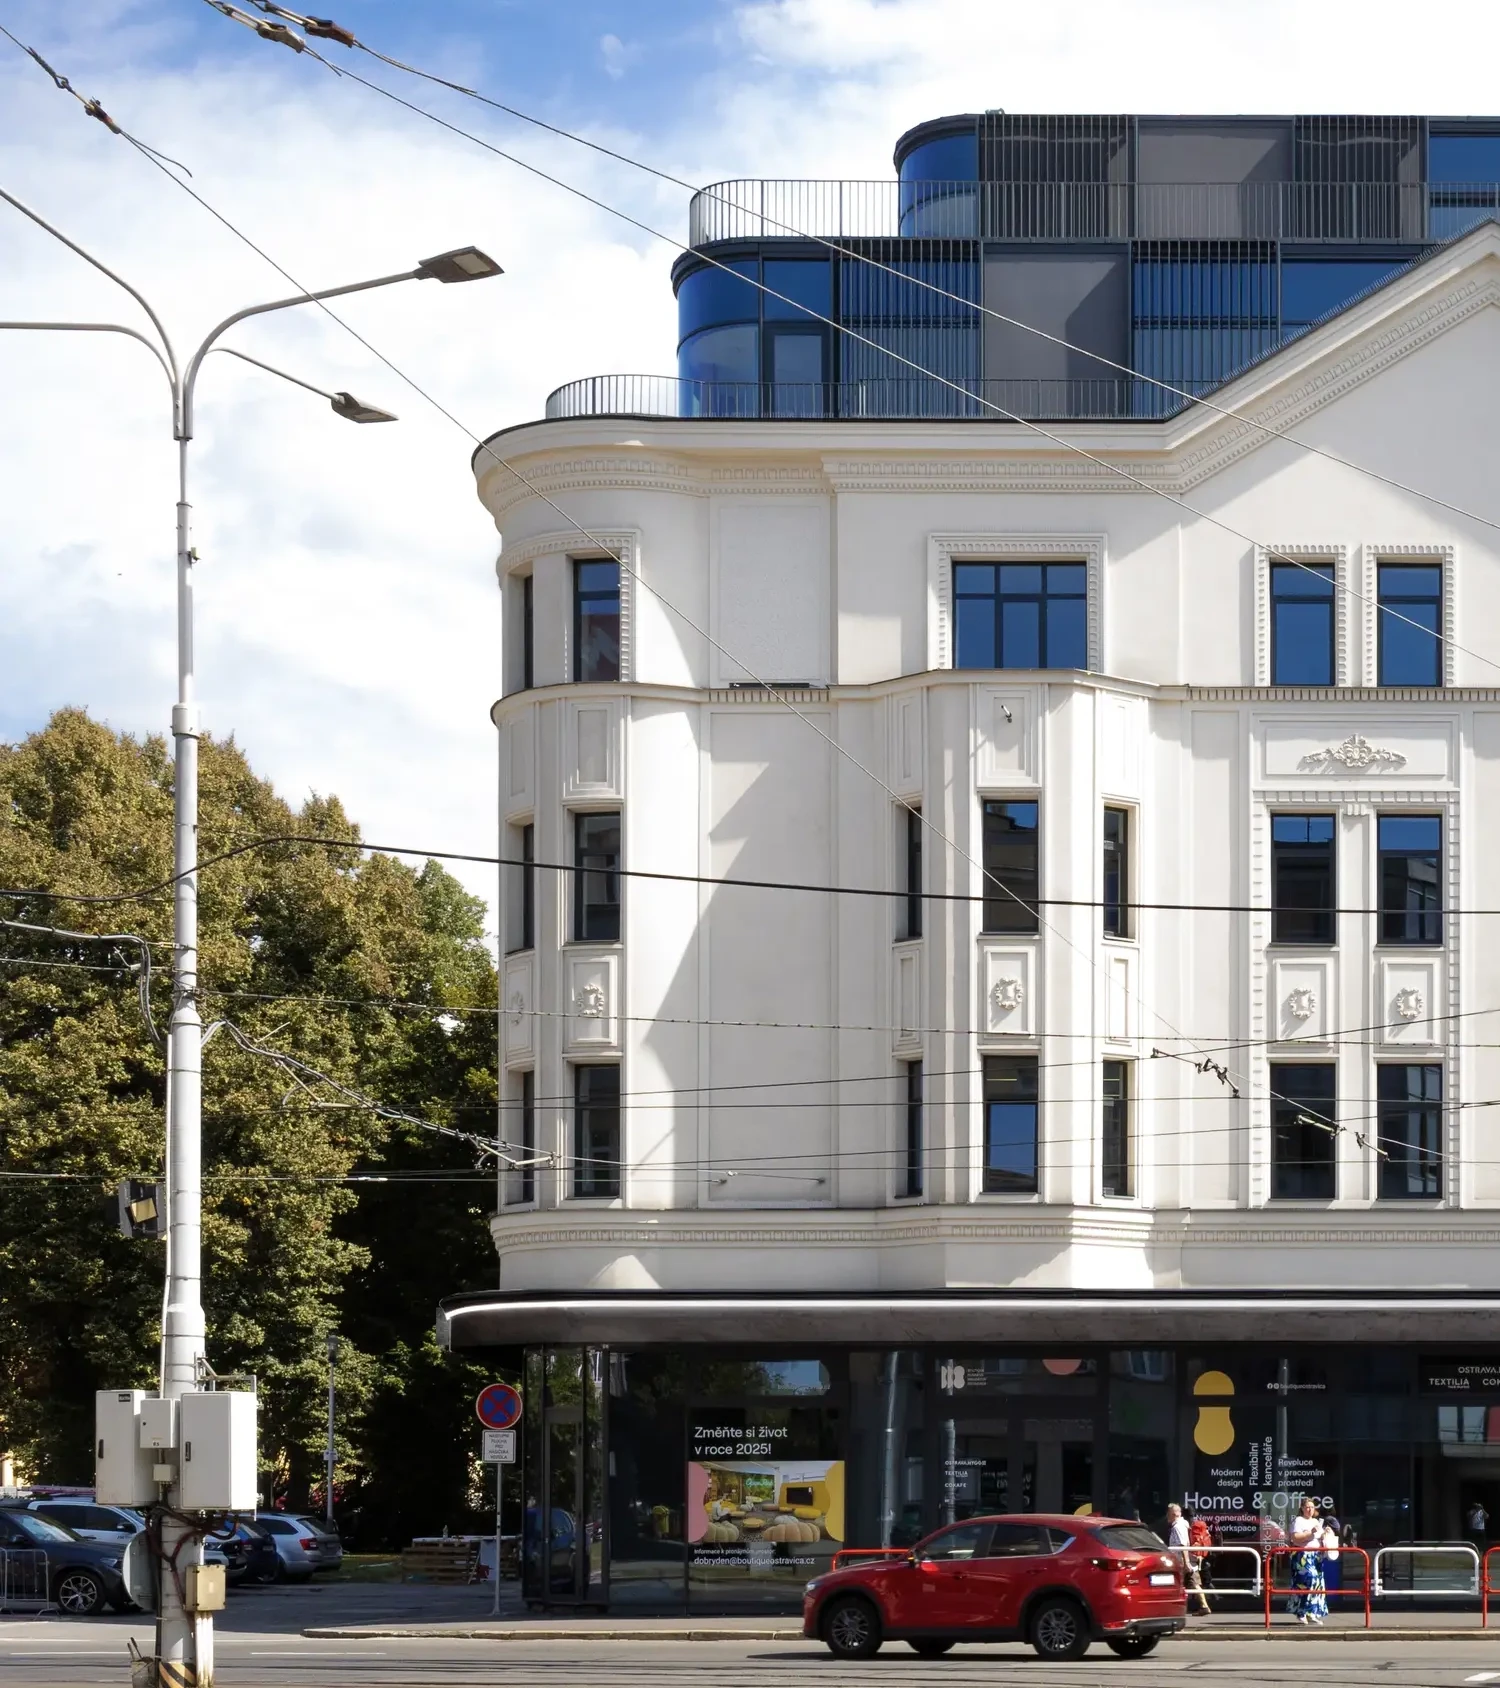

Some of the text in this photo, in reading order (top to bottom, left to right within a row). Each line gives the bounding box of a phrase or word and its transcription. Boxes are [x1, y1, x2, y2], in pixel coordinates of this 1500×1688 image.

[694, 1426, 788, 1438] Změňte si život
[694, 1443, 772, 1455] v roce 2025!
[1249, 1442, 1259, 1486] Flexibilní
[1263, 1436, 1273, 1486] kanceláře
[1278, 1458, 1313, 1466] Revoluce
[1211, 1468, 1244, 1477] Moderní
[1284, 1468, 1325, 1478] pracovním
[1217, 1479, 1243, 1489] design
[1278, 1479, 1314, 1489] prostředí
[1184, 1491, 1335, 1510] Home & Offce
[1215, 1514, 1257, 1523] generation
[1214, 1525, 1257, 1534] workspace
[694, 1556, 815, 1566] dobryden@boutiqueostravica.cz
